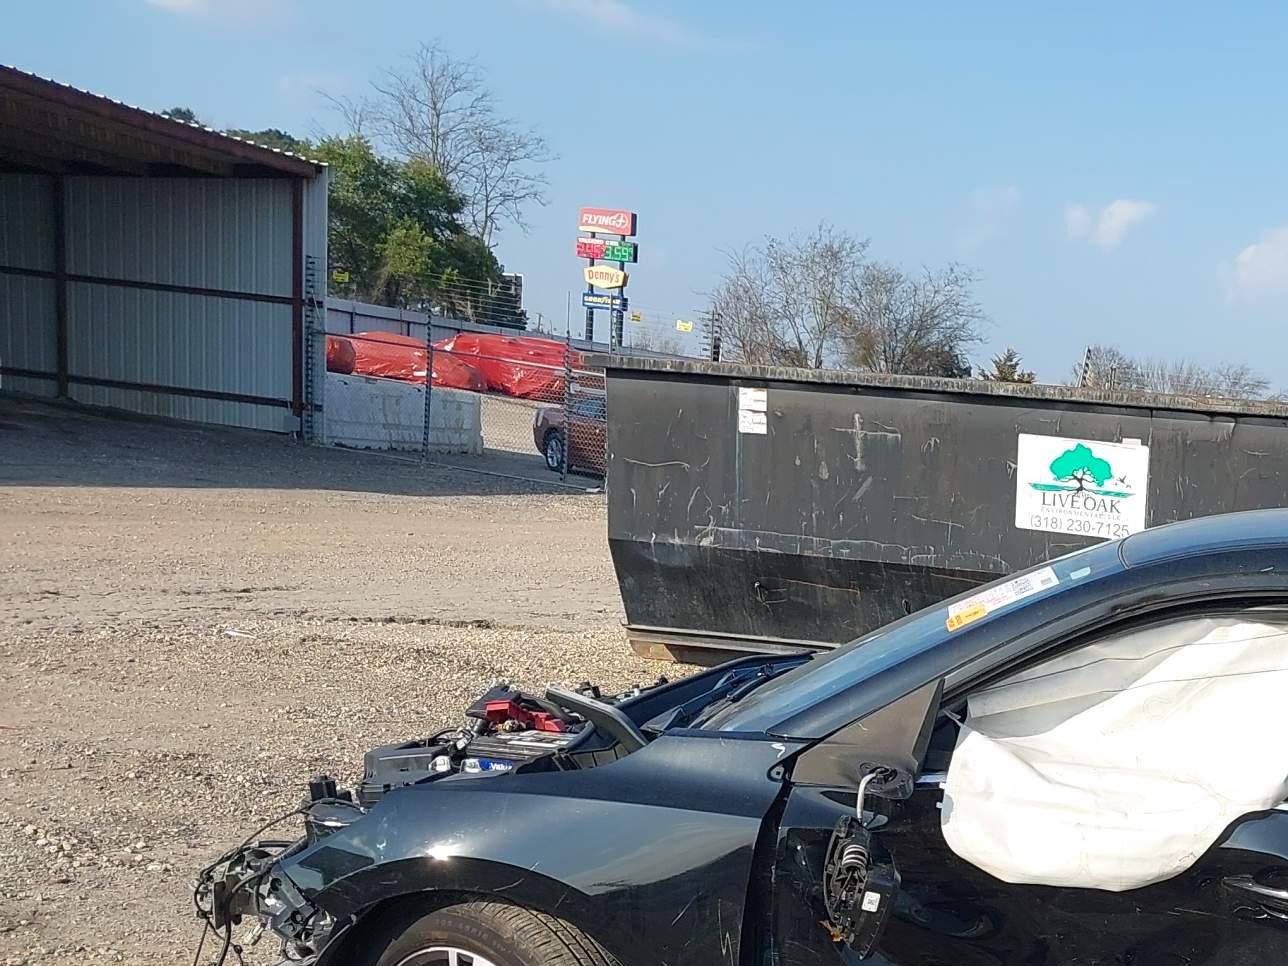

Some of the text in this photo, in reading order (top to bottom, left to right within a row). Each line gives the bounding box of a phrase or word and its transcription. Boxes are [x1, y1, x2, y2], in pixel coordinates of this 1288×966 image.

[582, 213, 617, 226] FLYING
[588, 270, 620, 283] Denny's
[1041, 492, 1121, 514] LIVE OAK
[1030, 514, 1130, 538] (318) 230-7125
